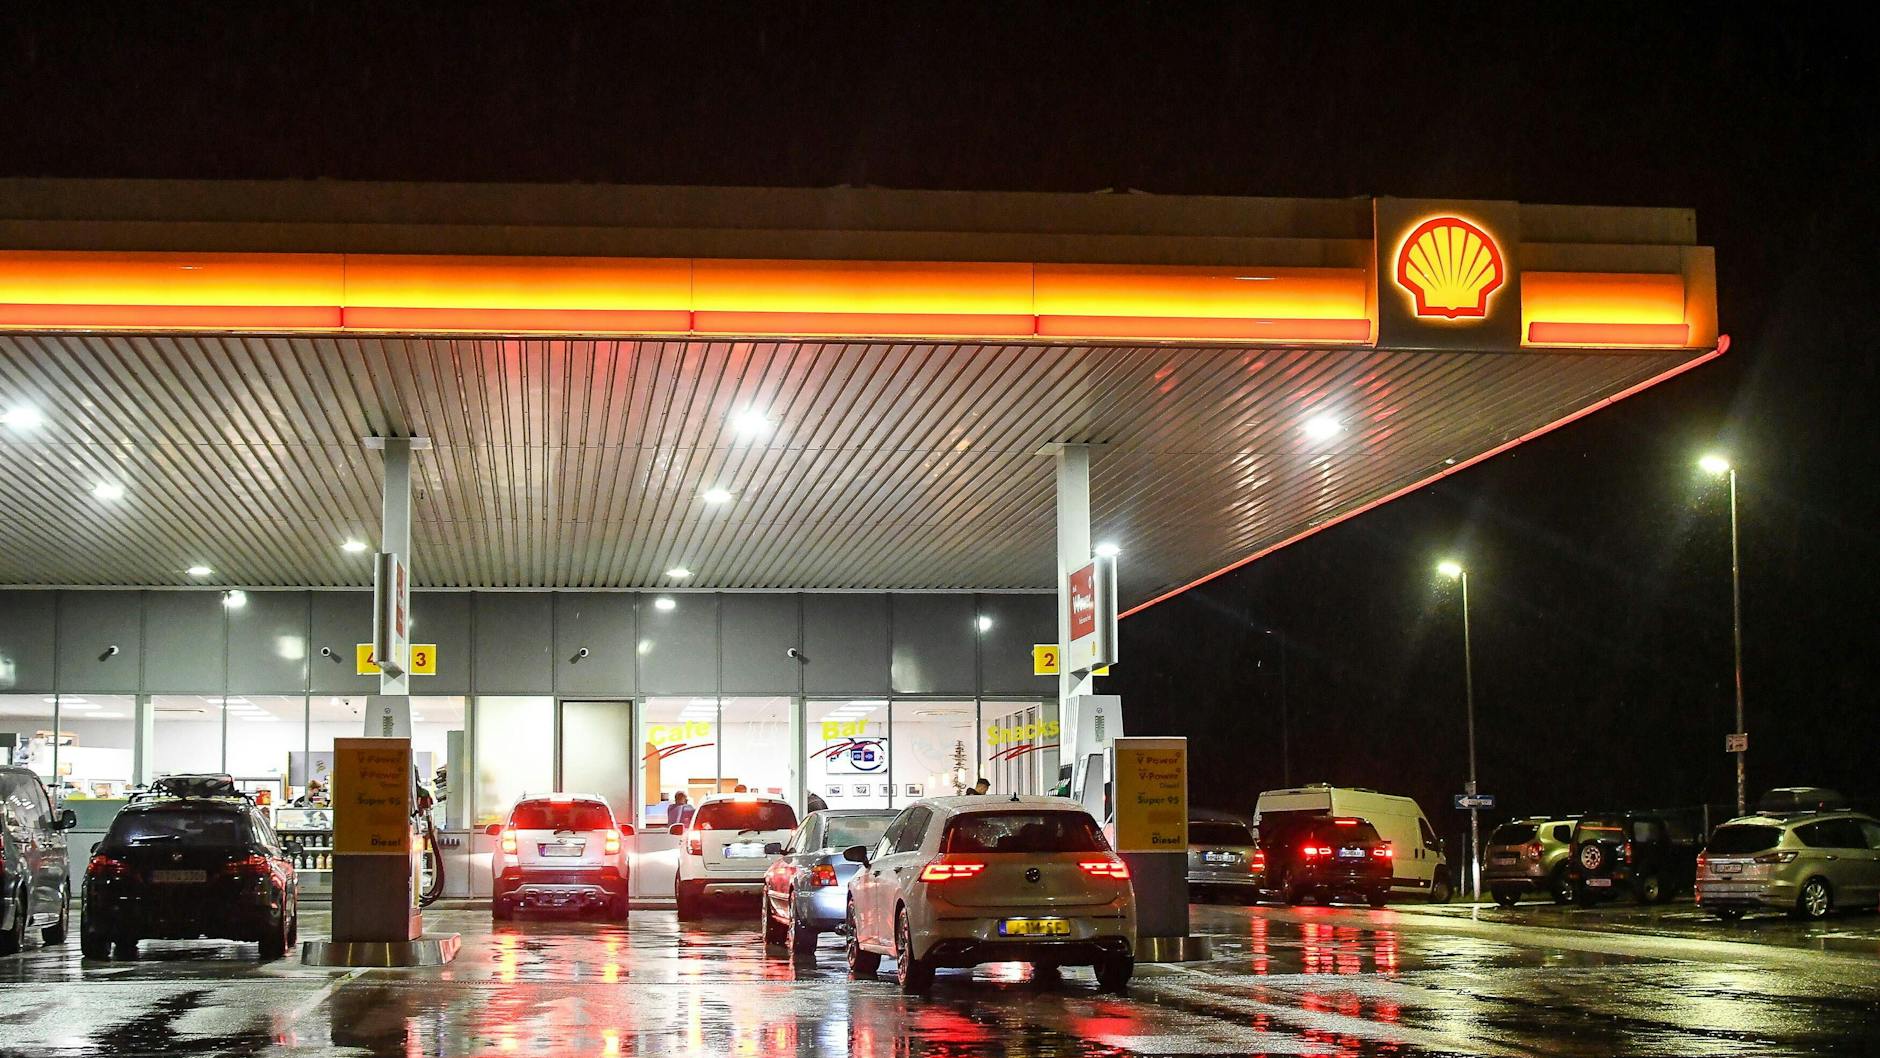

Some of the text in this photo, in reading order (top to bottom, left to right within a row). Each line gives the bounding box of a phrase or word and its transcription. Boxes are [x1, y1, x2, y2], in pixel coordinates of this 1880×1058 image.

[415, 652, 427, 667] 3
[1044, 653, 1055, 667] 2
[822, 718, 868, 740] Bar
[986, 717, 1060, 746] Snacks
[1137, 795, 1179, 805] Super 95
[1152, 835, 1180, 844] Diesel
